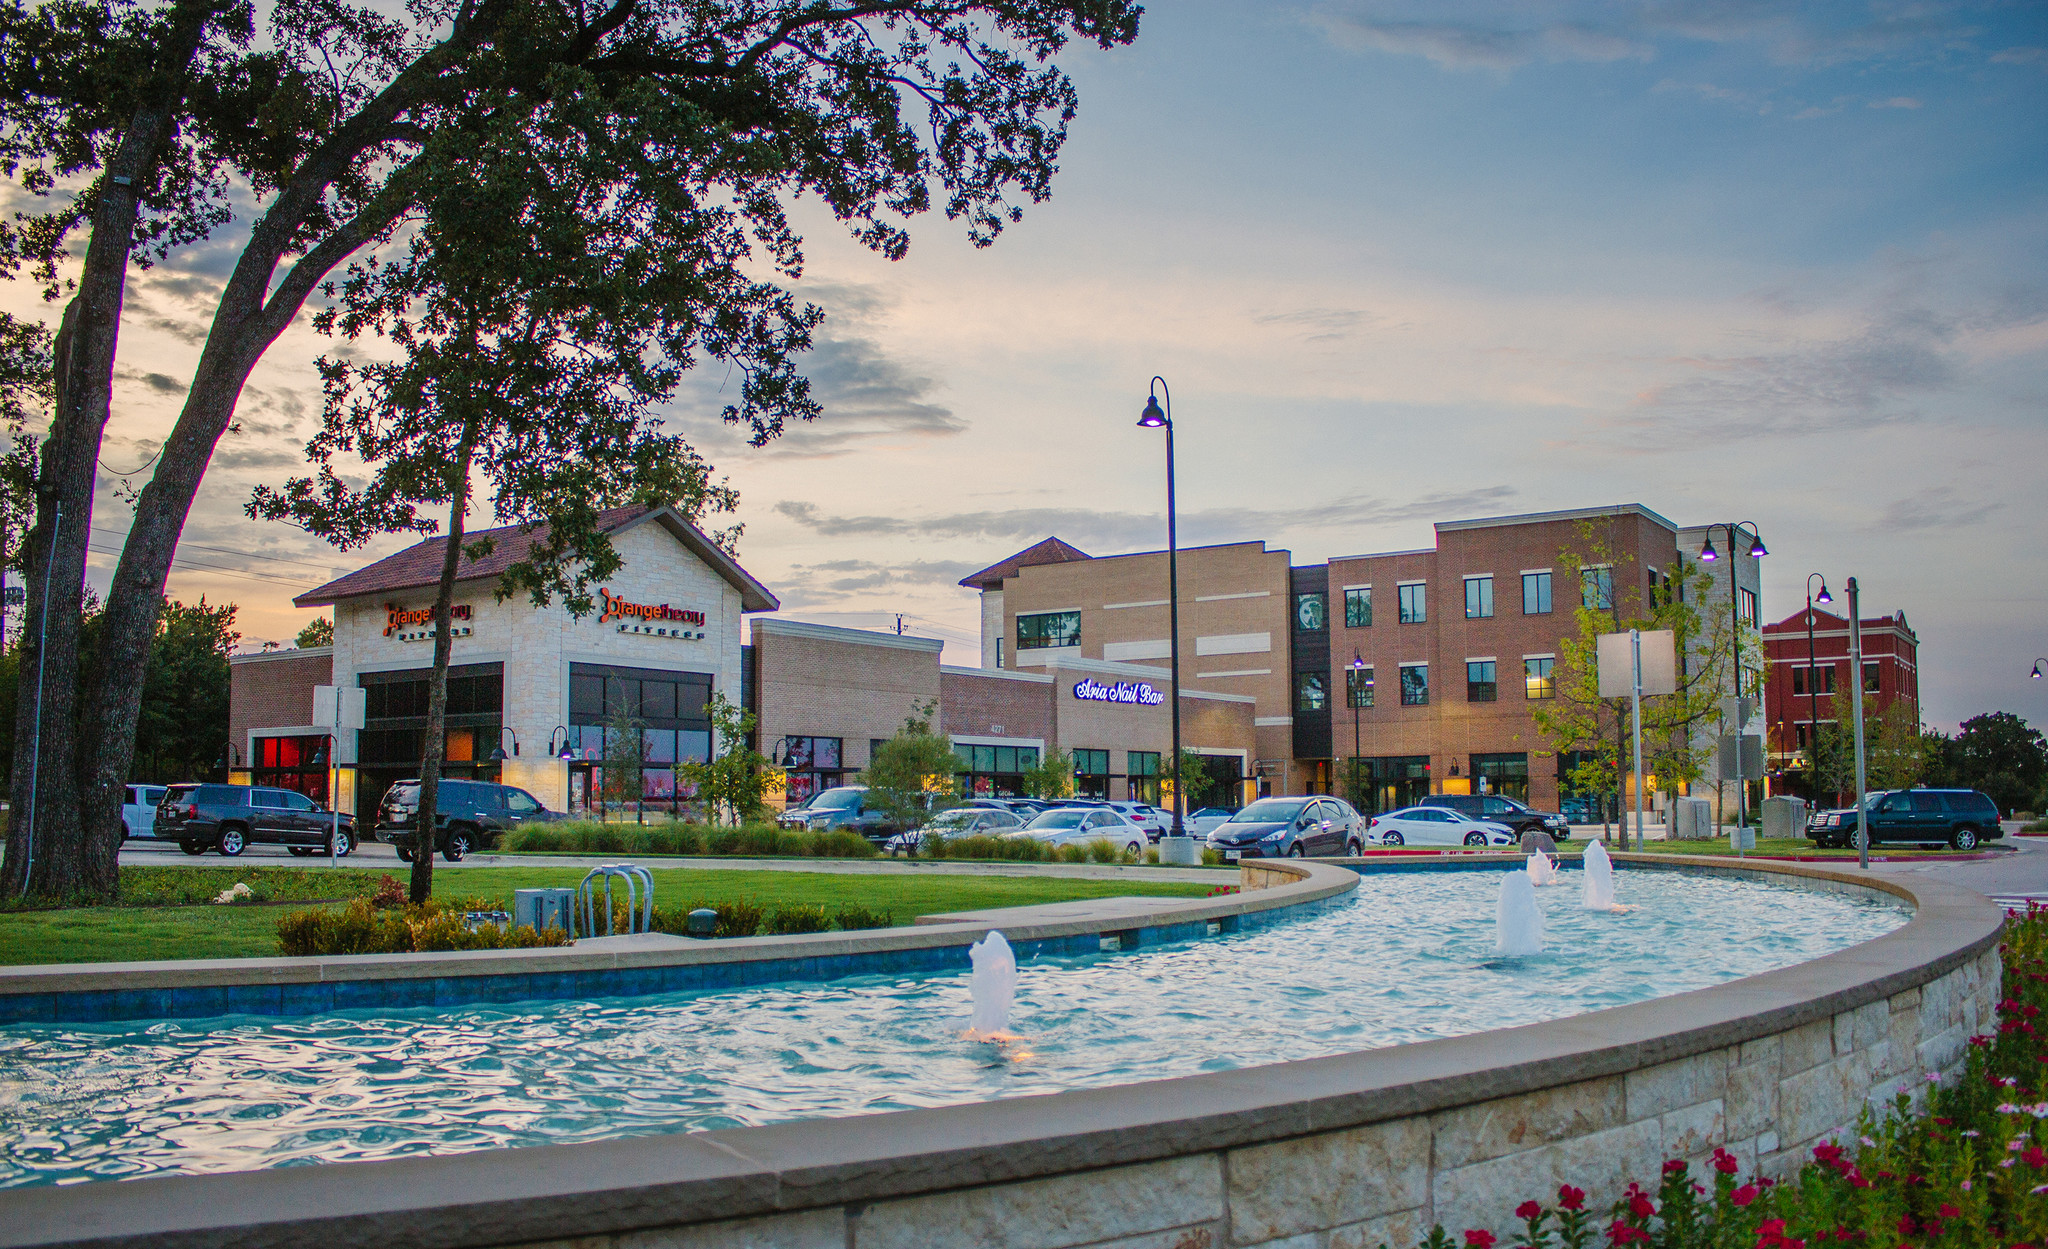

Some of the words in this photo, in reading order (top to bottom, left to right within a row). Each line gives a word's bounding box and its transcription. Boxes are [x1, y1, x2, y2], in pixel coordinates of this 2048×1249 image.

[599, 587, 705, 627] Orangetheory
[383, 603, 472, 636] Orangetory
[398, 627, 471, 641] FITNSS
[620, 624, 705, 639] FITNESS
[1076, 679, 1108, 699] Aria
[1108, 682, 1139, 702] Nail
[1139, 684, 1164, 704] Bar
[991, 724, 1005, 734] 4271
